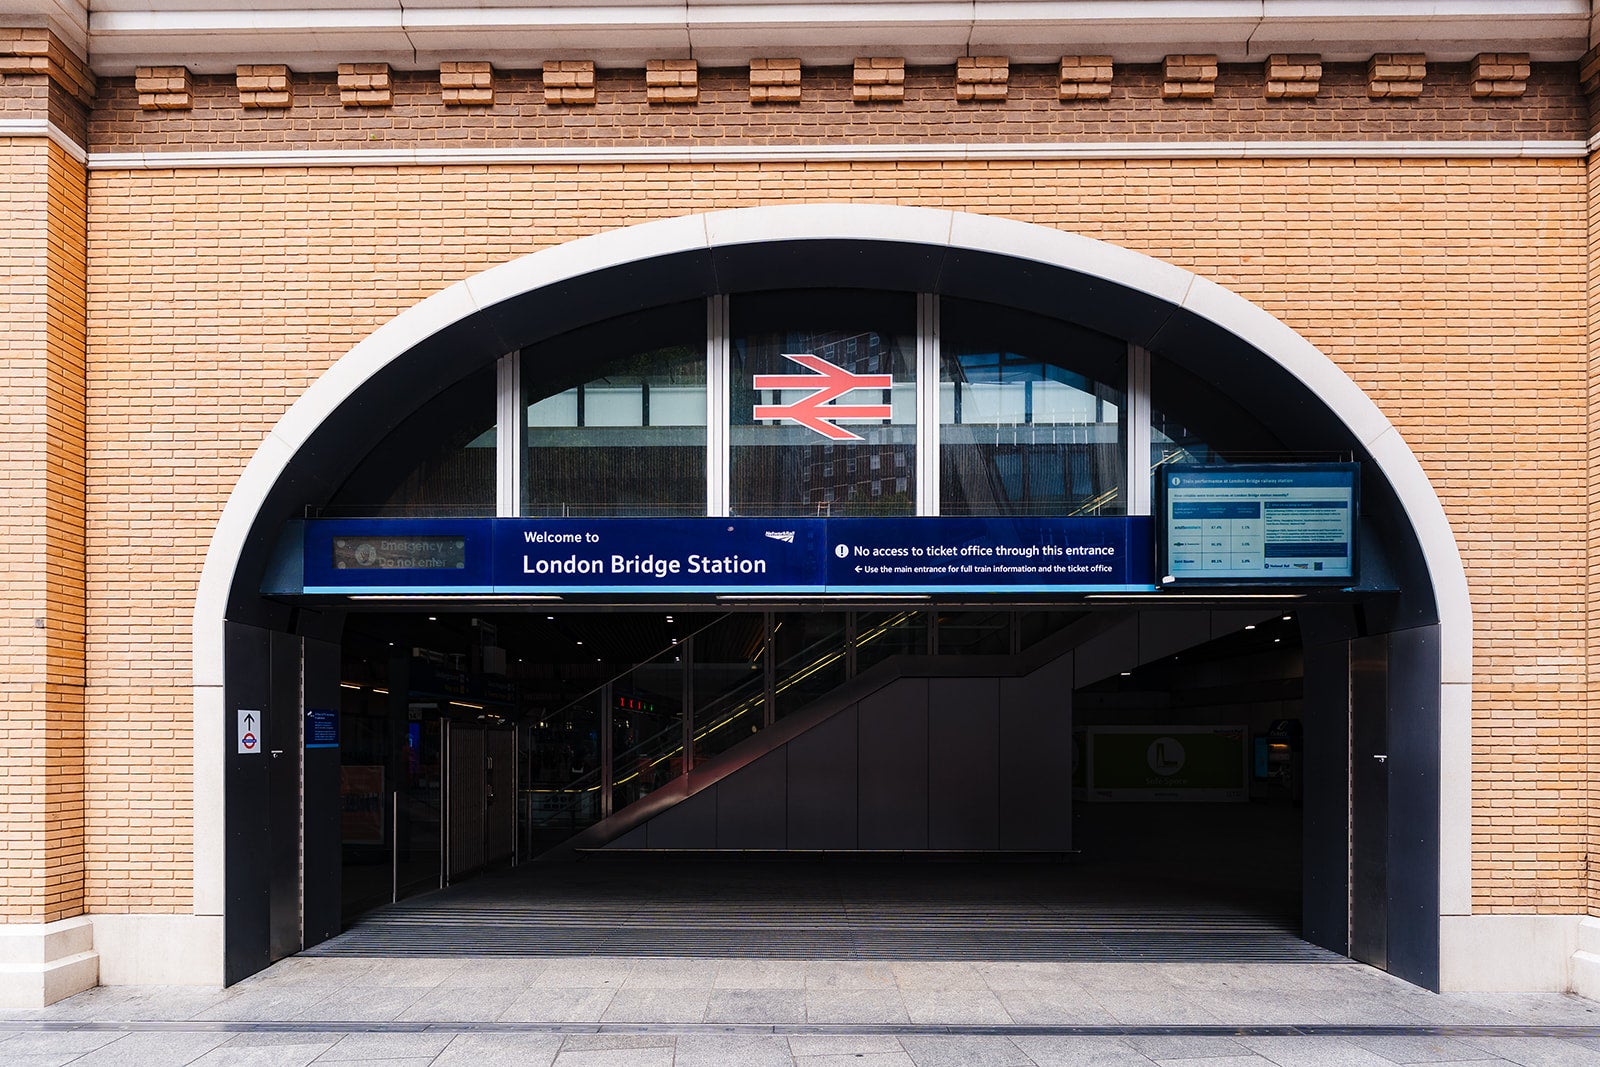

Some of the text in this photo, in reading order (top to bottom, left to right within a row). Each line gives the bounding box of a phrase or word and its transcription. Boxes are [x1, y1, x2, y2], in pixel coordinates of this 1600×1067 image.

[524, 531, 600, 543] Welcome to
[381, 540, 443, 553] Emergency
[854, 545, 1115, 558] No access to ticket office through this entrance
[379, 557, 446, 567] Do not enter
[523, 554, 766, 578] London Bridge Station
[864, 565, 1112, 573] Use the main entrance for full train information and the ticket office
